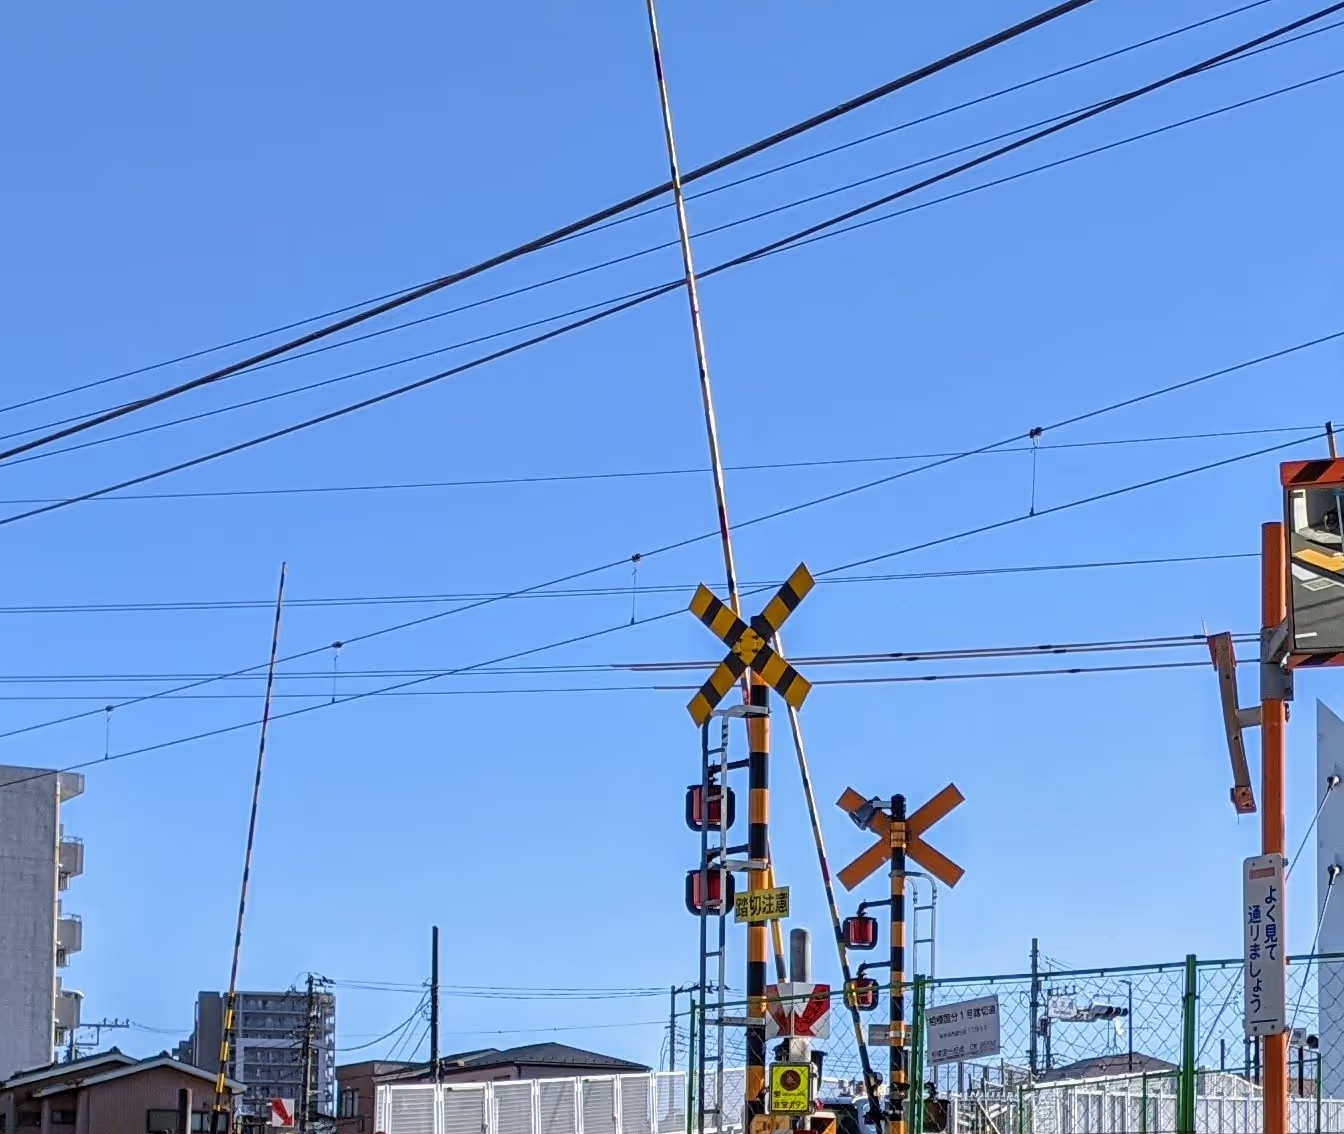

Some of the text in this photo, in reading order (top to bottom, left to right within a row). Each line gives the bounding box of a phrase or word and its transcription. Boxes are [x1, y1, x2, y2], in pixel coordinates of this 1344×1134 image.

[736, 892, 788, 917] 踏切注意
[1264, 885, 1278, 961] よく見て
[1248, 904, 1263, 1014] 通りましょう
